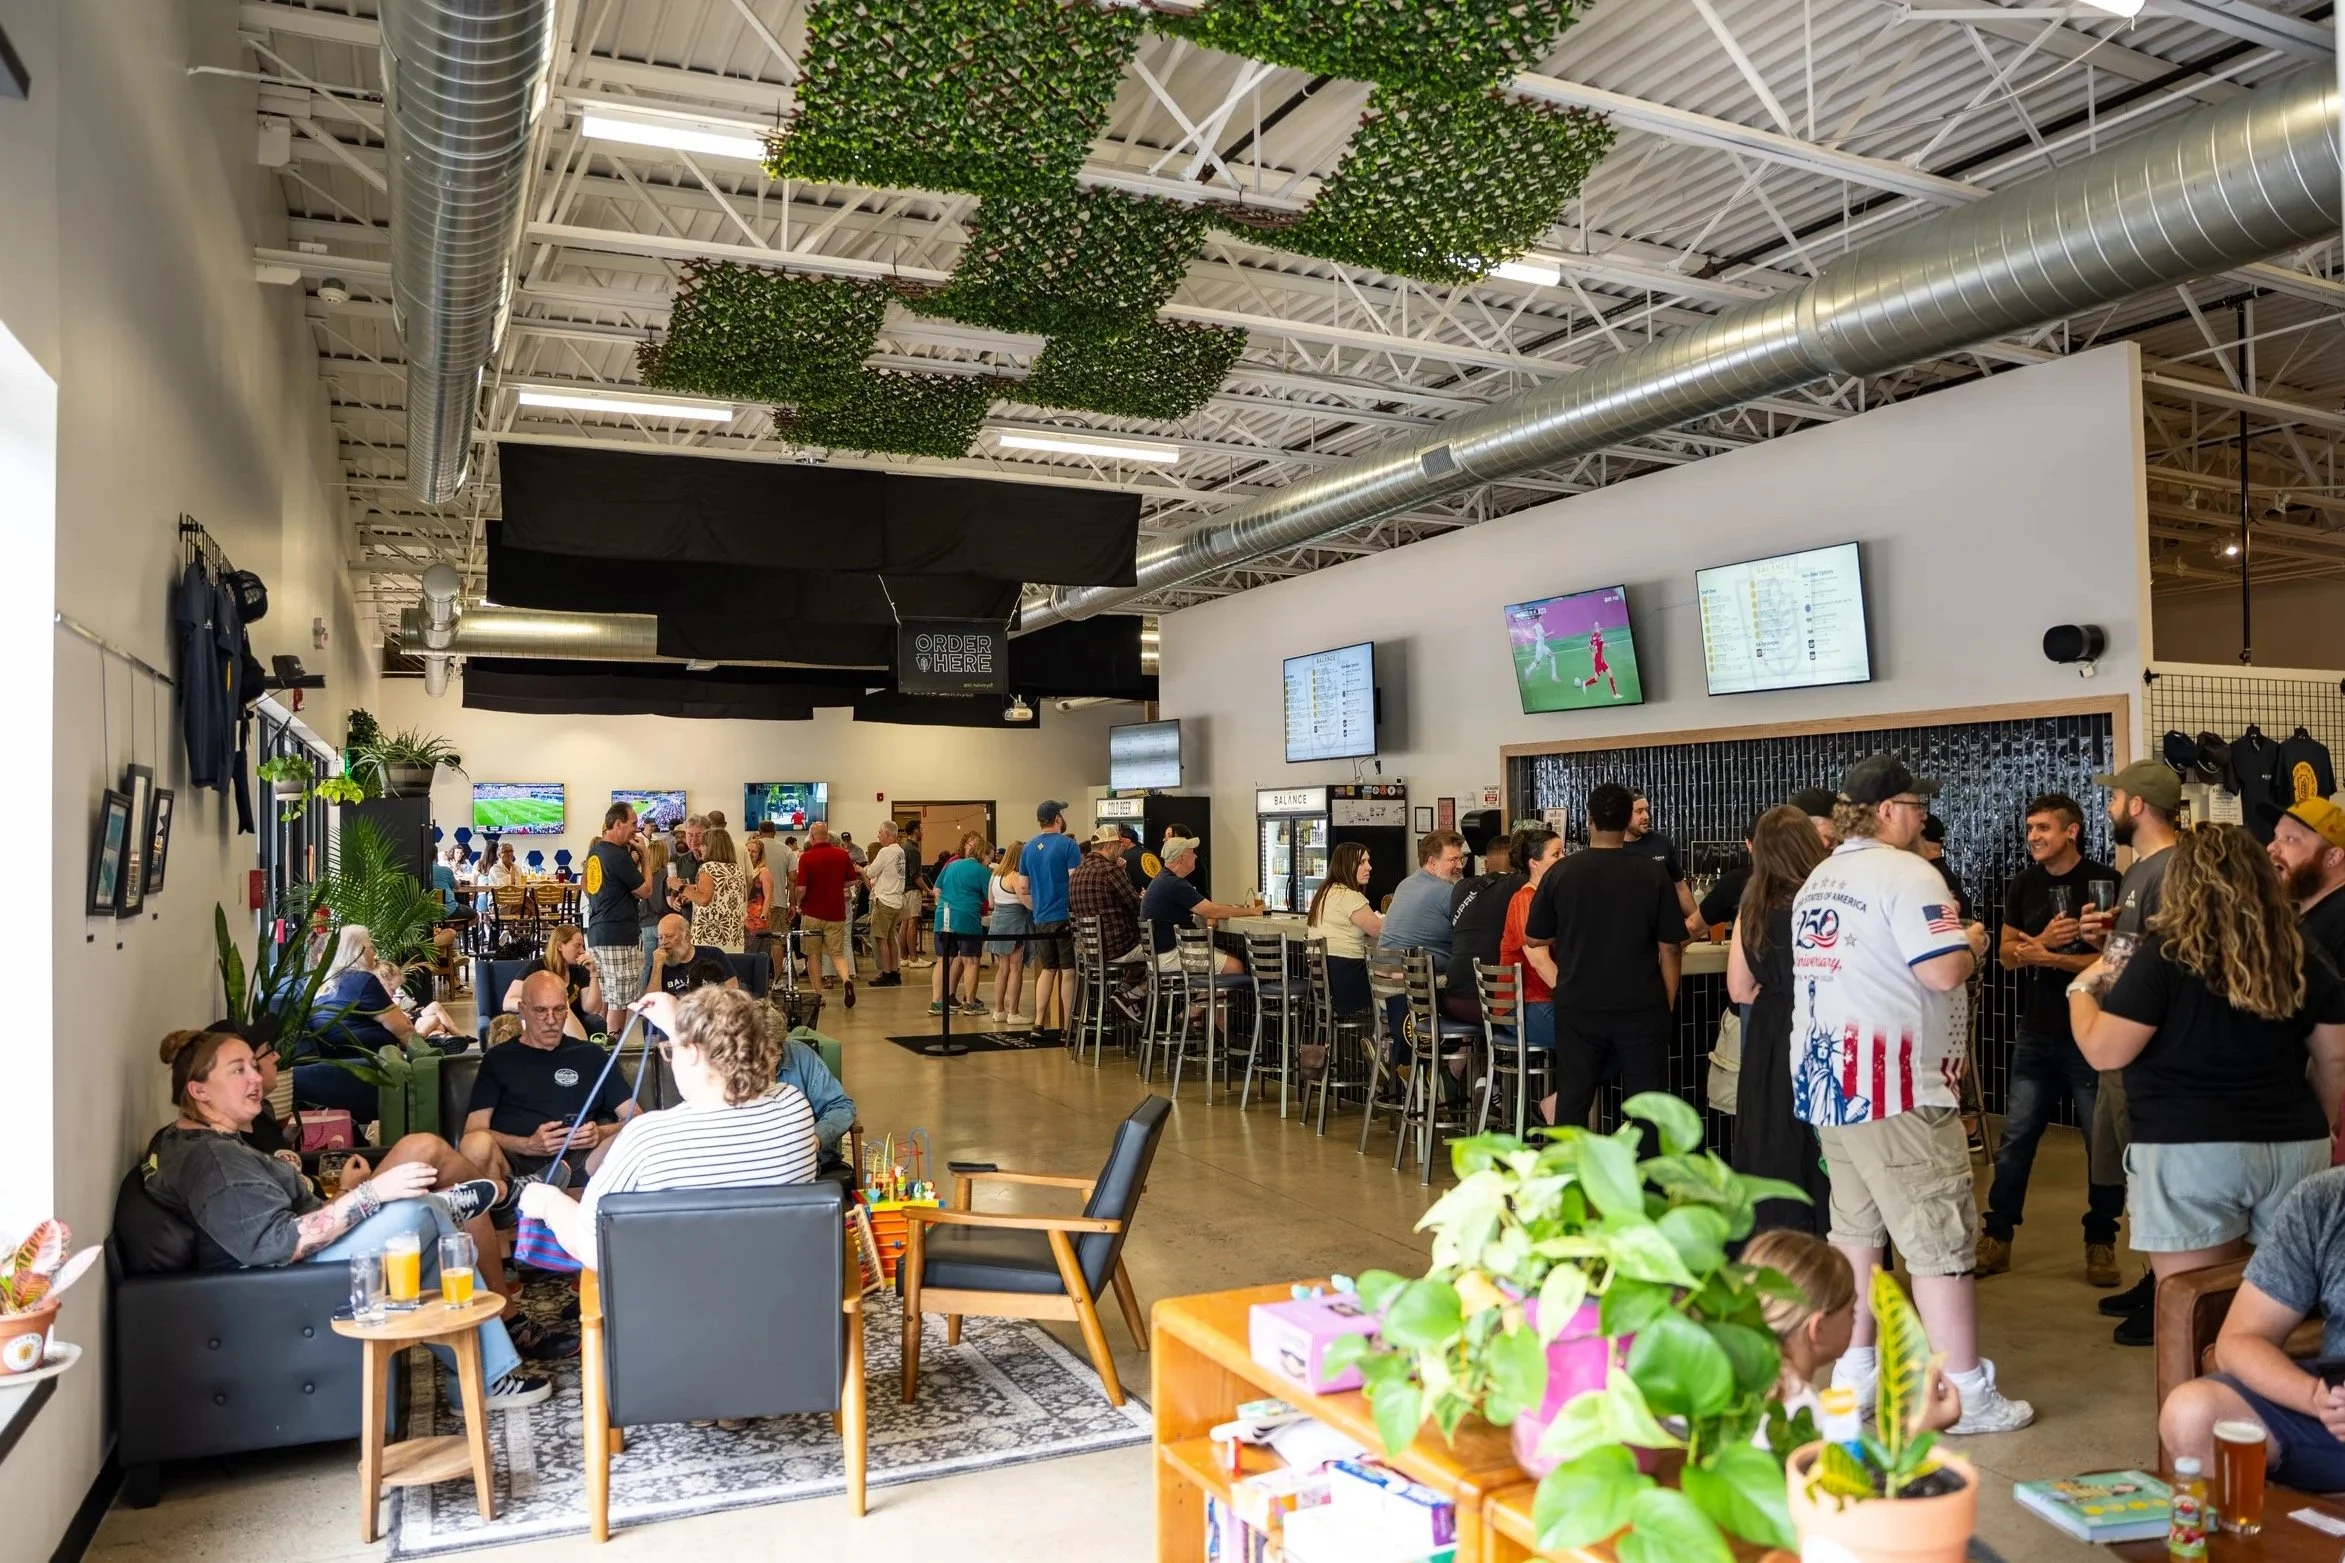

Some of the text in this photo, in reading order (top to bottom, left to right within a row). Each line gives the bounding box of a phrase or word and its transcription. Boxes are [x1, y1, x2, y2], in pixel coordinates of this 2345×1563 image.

[915, 633, 992, 654] ORDER
[933, 653, 993, 673] HERE
[1120, 801, 1132, 815] BEER
[1274, 794, 1307, 806] BALANCE
[1832, 892, 1867, 913] AMERICA
